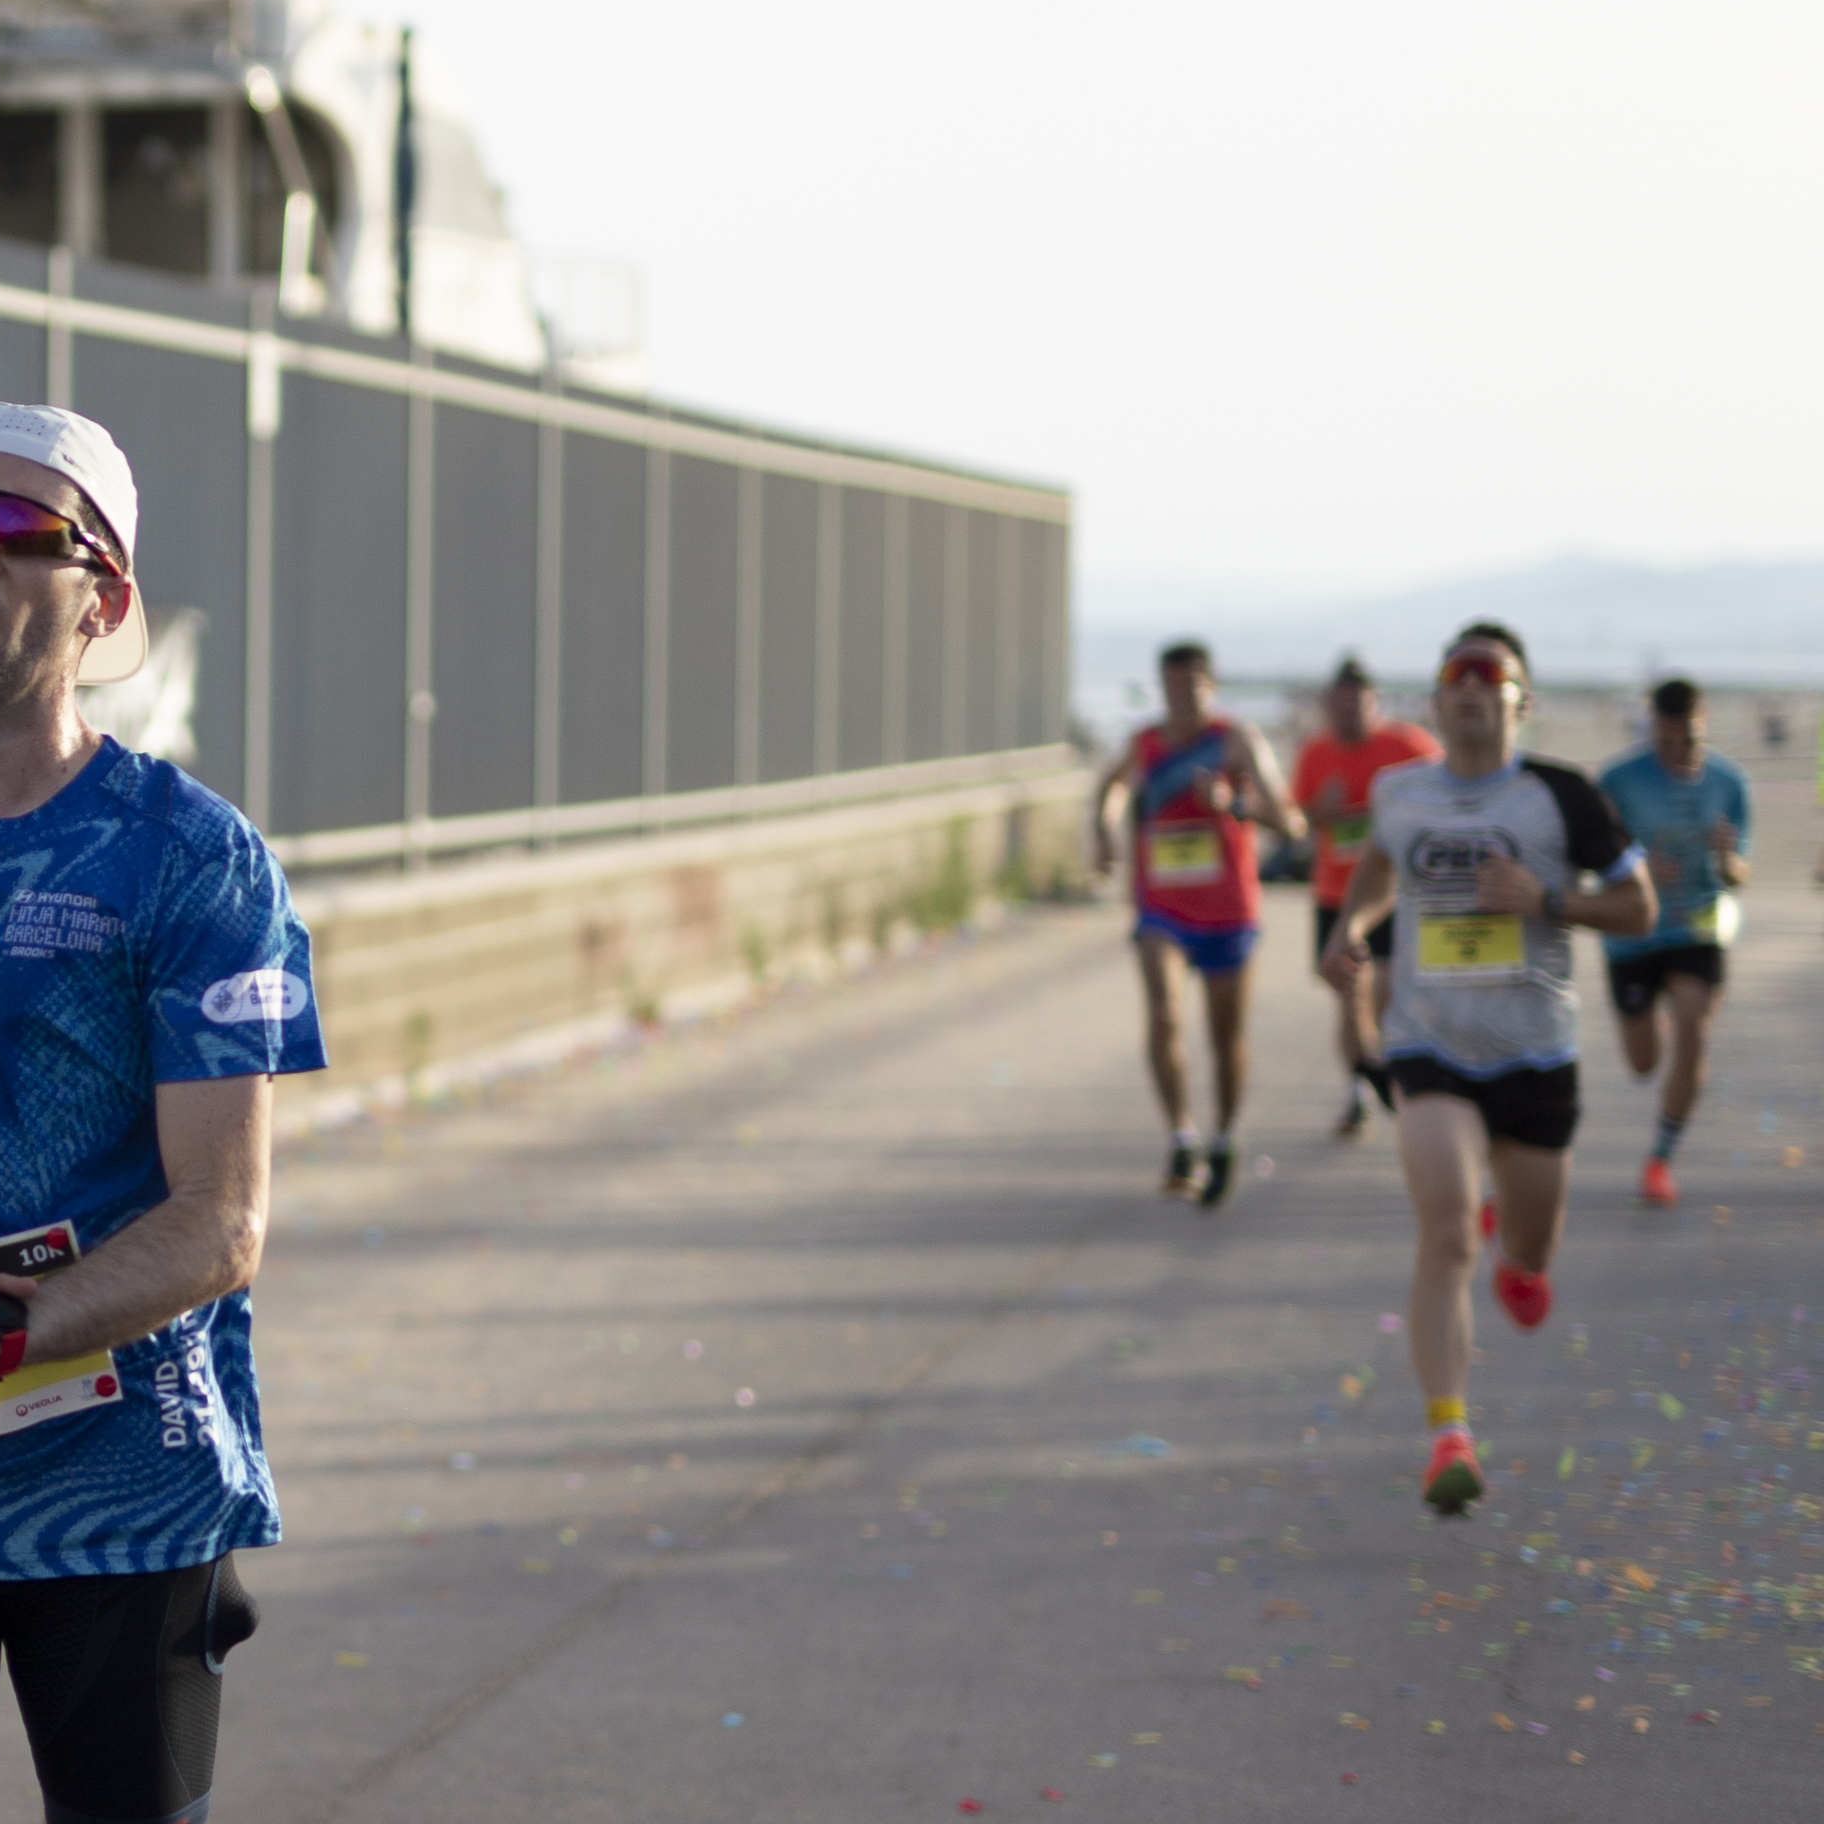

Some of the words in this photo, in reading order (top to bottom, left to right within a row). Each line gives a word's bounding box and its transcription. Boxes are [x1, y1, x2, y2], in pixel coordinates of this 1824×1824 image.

[37, 891, 97, 908] HYUNDAI
[3, 924, 104, 953] BARCELONA
[10, 945, 56, 959] BROOKS
[155, 1360, 187, 1448] DAVID
